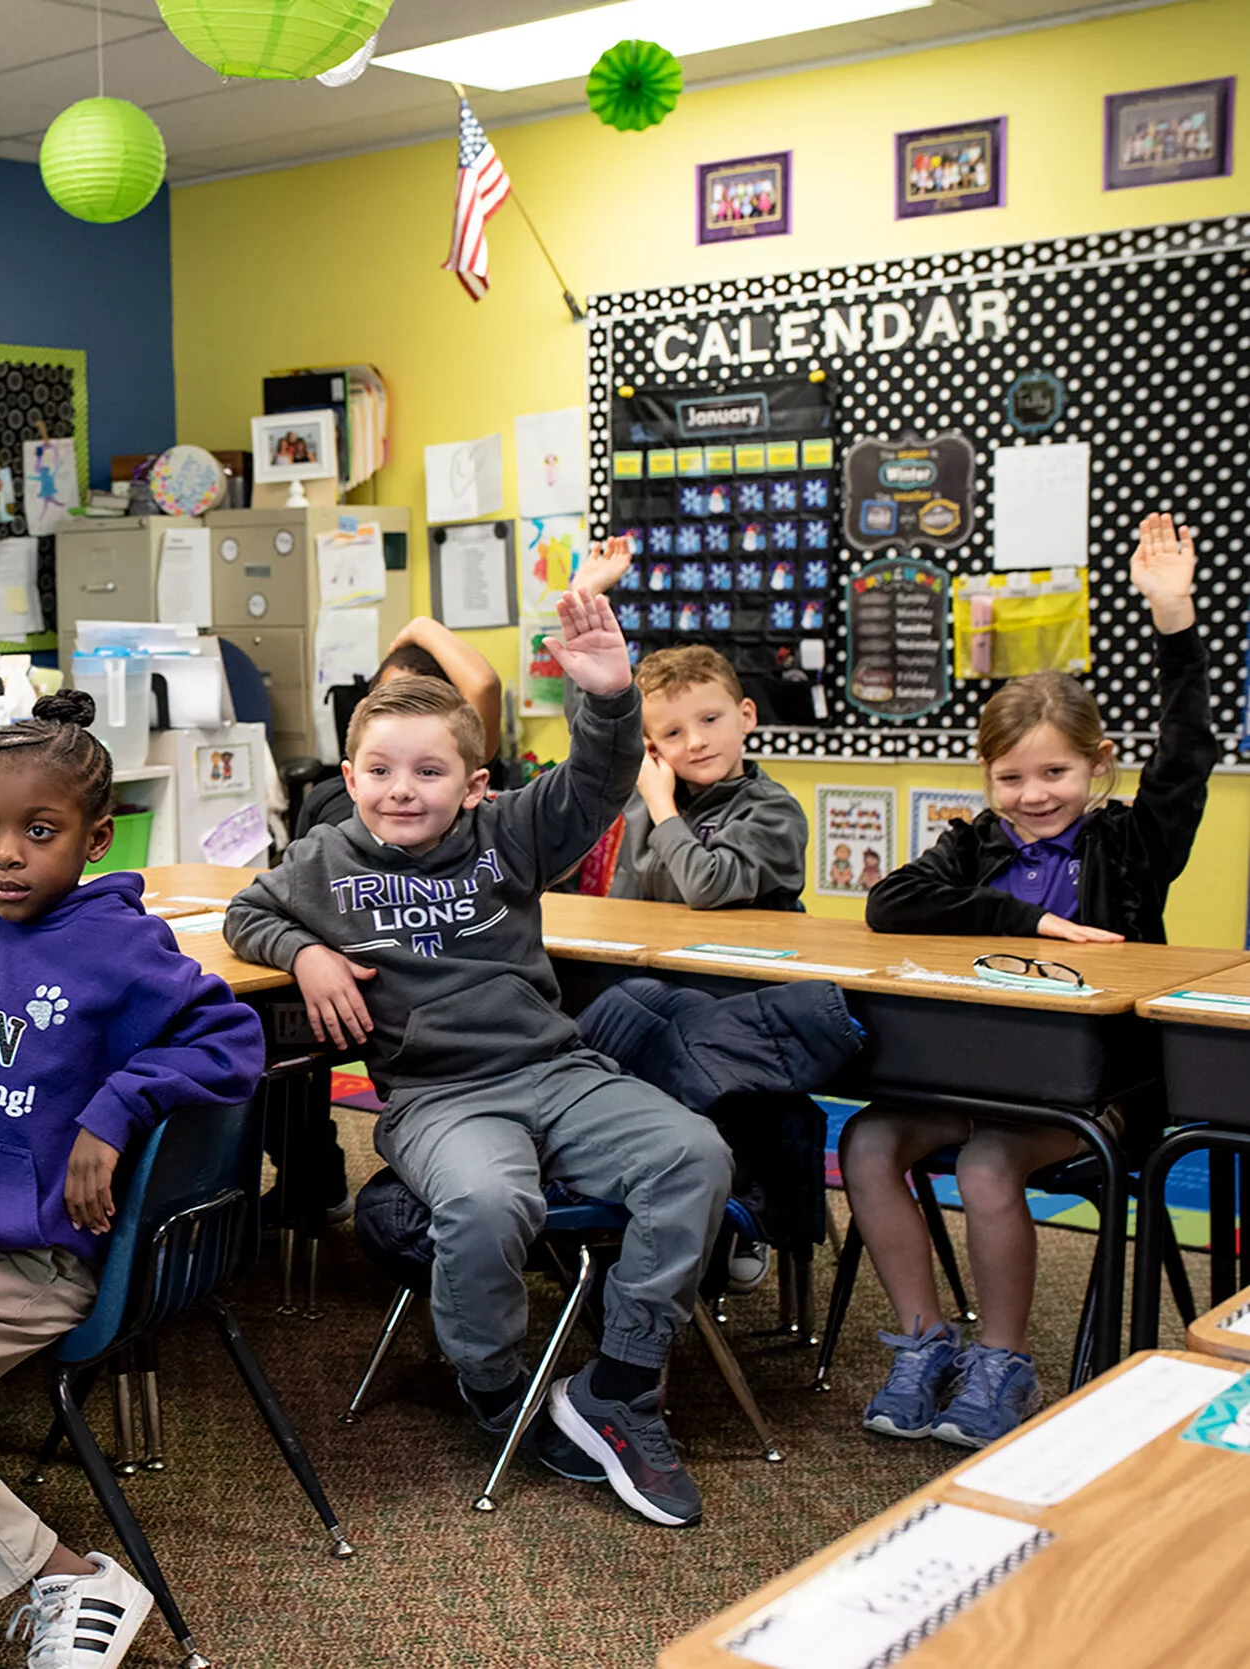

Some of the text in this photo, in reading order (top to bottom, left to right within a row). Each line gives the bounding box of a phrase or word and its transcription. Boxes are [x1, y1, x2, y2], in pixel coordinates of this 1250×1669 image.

[653, 290, 1010, 371] CALENDAR
[687, 403, 760, 427] January
[885, 465, 931, 482] Winter
[895, 622, 933, 635] Tuesday
[897, 671, 929, 684] Friday
[895, 685, 937, 700] Saturday
[372, 898, 477, 931] LIONS
